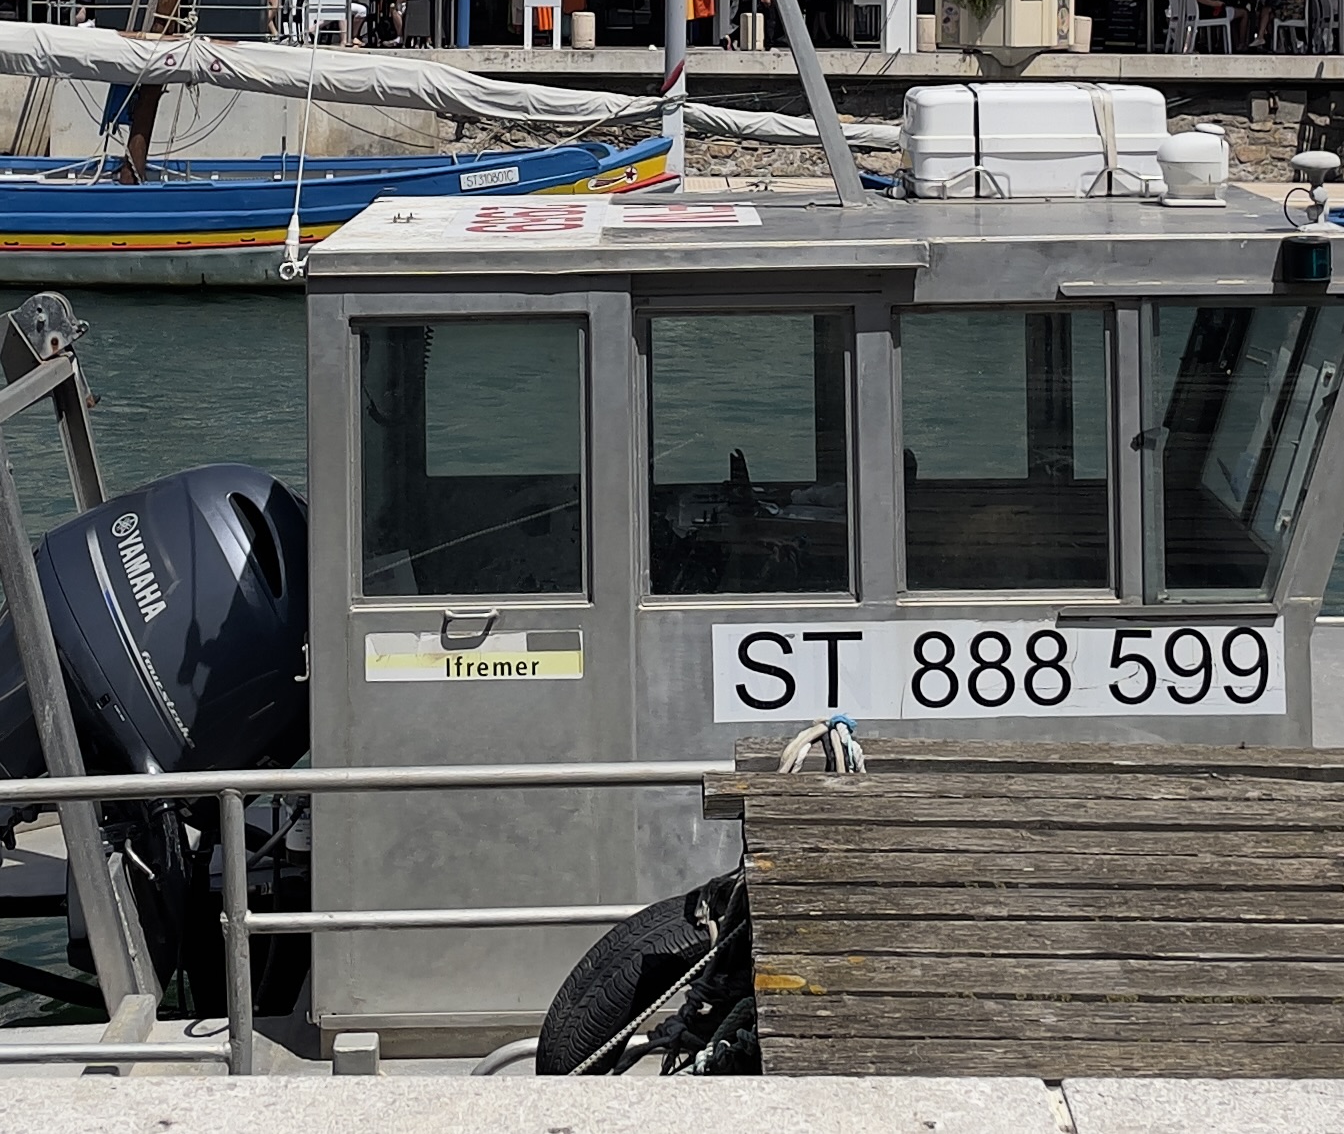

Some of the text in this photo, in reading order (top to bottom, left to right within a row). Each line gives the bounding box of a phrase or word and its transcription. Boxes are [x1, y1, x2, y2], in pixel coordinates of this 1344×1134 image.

[117, 529, 167, 623] YAMAHA
[446, 655, 540, 677] Ifremer
[735, 627, 1270, 709] ST 888 599
